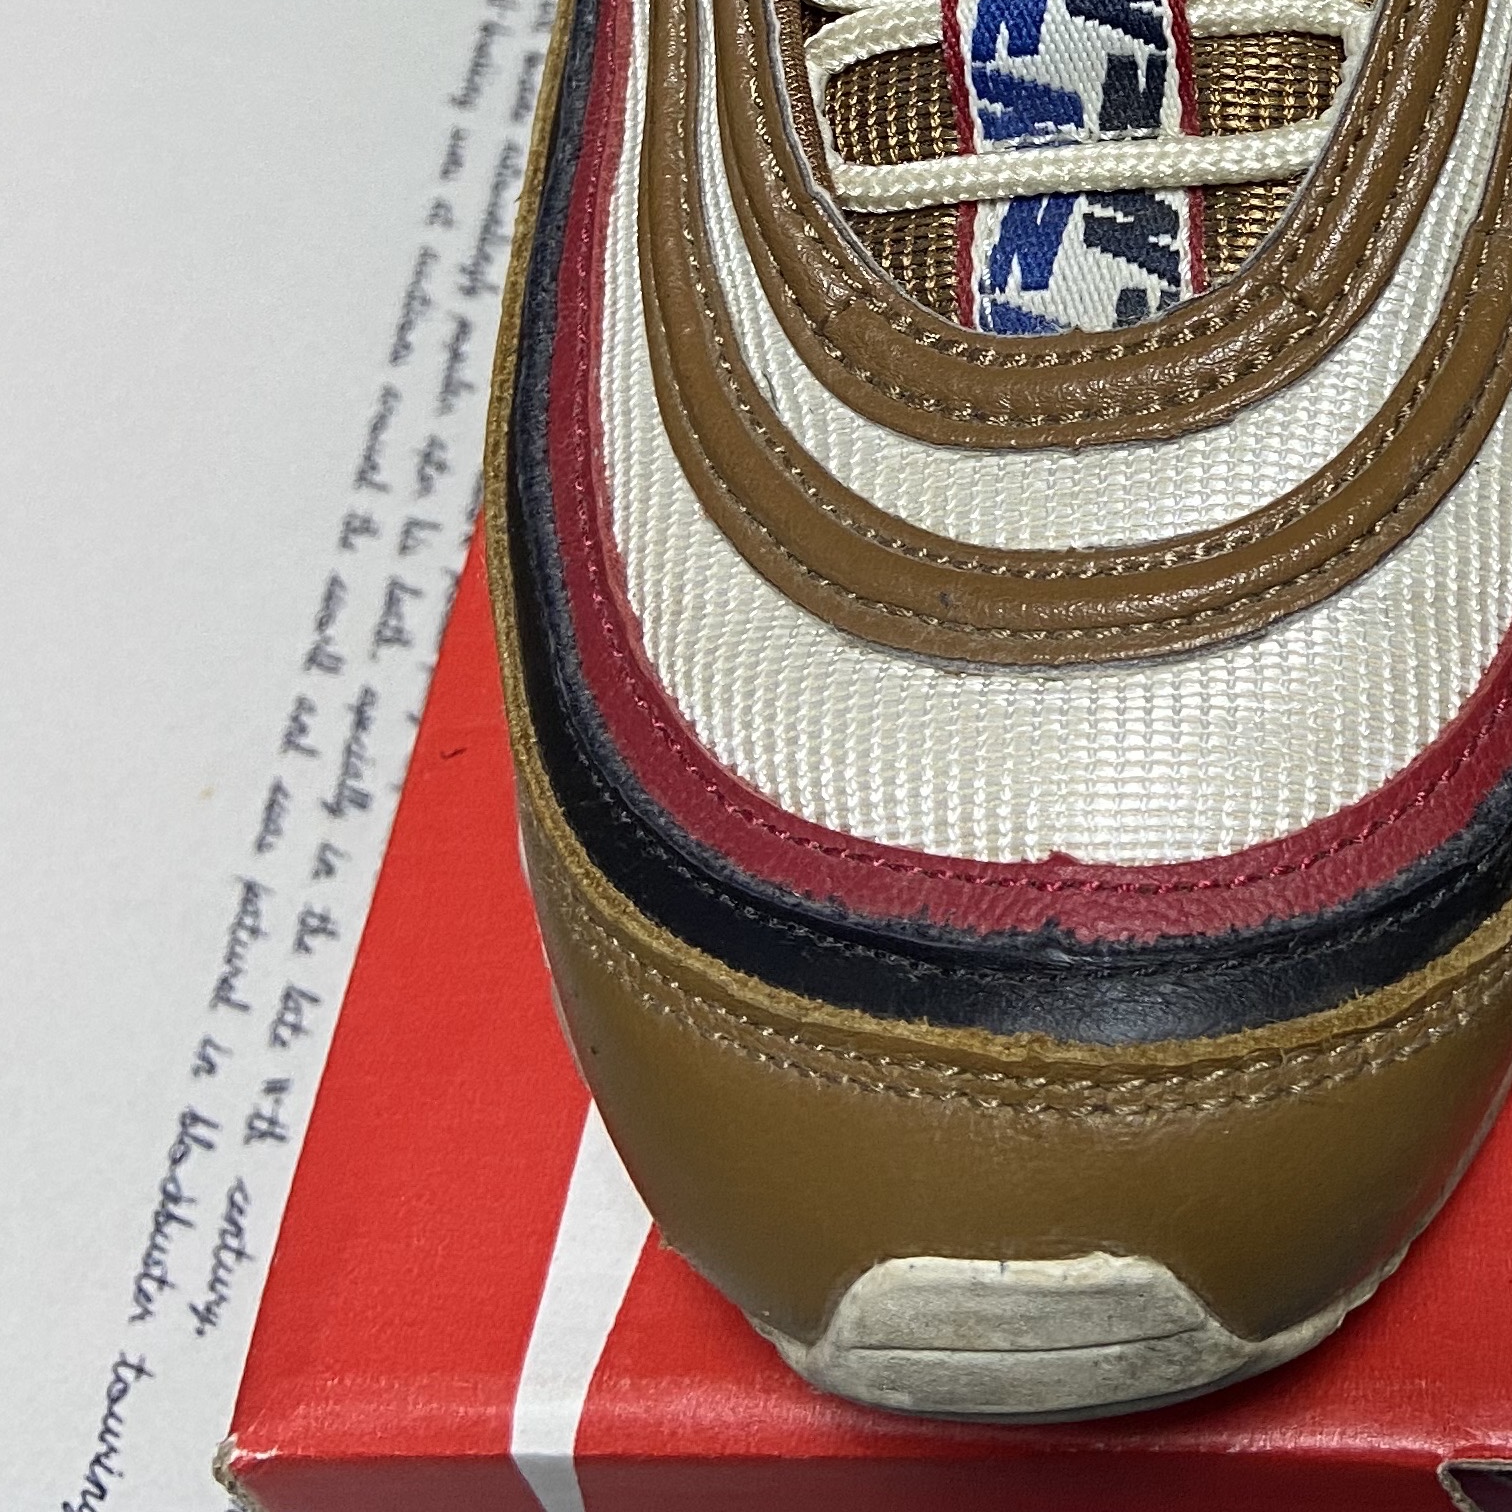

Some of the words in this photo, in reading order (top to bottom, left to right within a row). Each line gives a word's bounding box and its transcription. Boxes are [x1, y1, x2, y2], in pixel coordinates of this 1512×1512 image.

[277, 694, 321, 759] and
[289, 903, 340, 956] the
[266, 982, 322, 1051] late
[188, 1033, 233, 1079] in
[126, 1104, 220, 1326] blockbuster
[186, 1175, 256, 1339] century.
